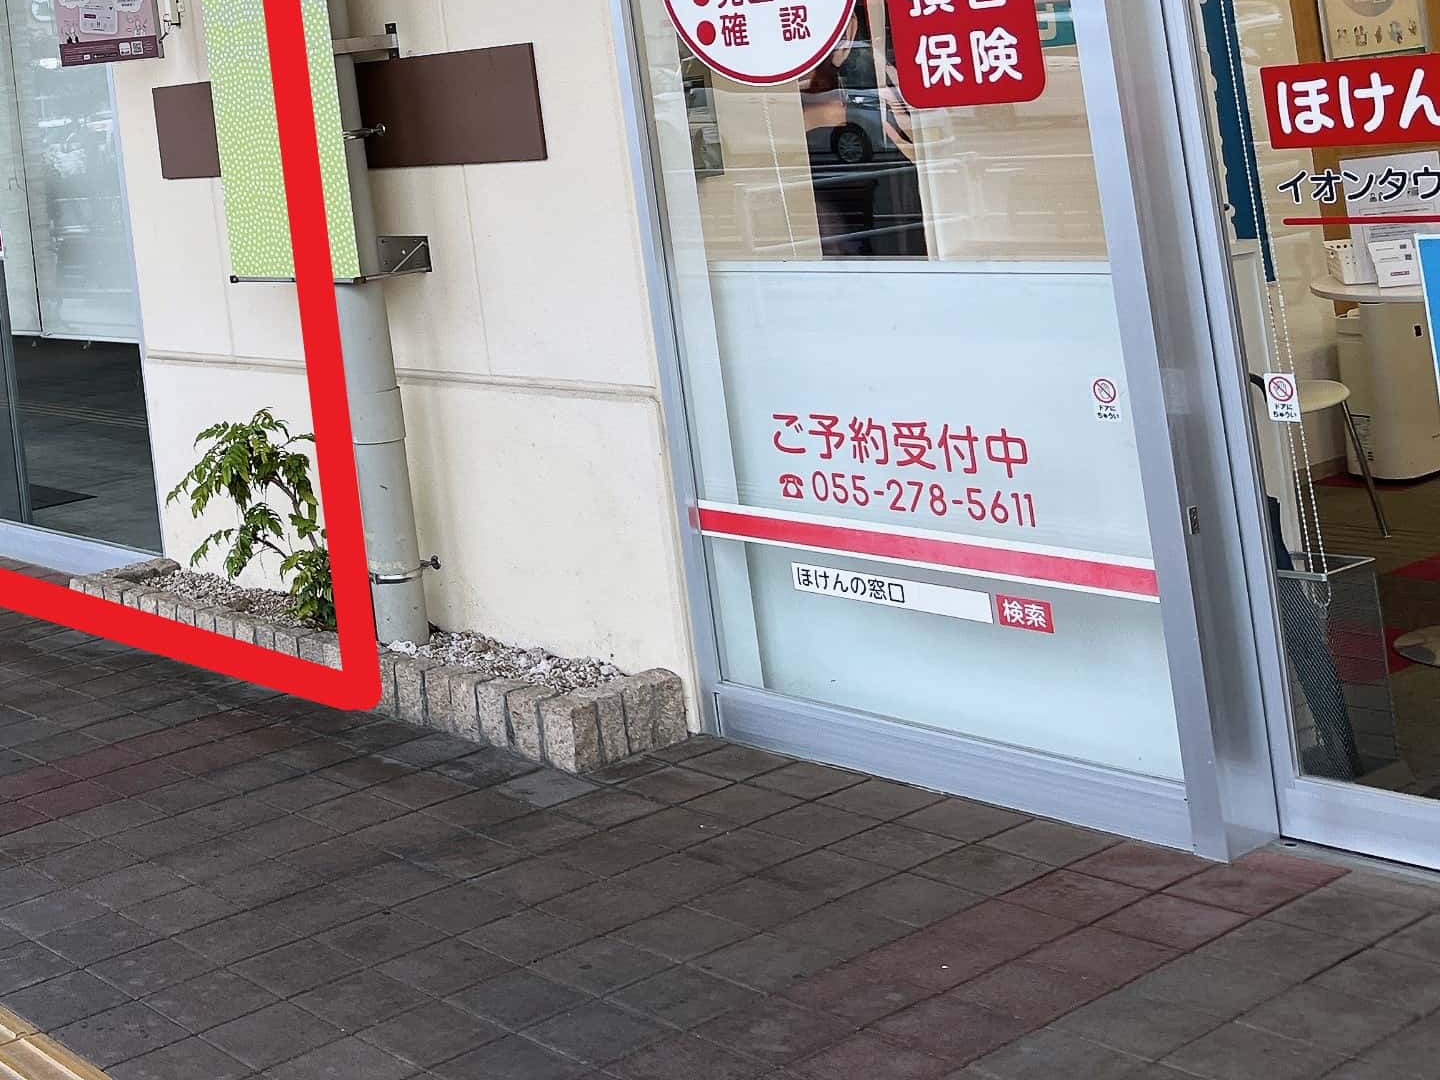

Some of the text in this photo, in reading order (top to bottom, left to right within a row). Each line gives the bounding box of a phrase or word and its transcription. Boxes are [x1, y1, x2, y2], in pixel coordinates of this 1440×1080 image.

[914, 26, 1023, 89] 保険
[1276, 68, 1440, 135] ほけん
[1278, 167, 1440, 204] イオンタウ
[1274, 403, 1293, 411] ドアに
[772, 413, 1028, 478] ご予約受付中
[811, 470, 1036, 528] 055-278-5611
[796, 566, 905, 604] ほけんの窓口
[1002, 599, 1047, 628] 検索
